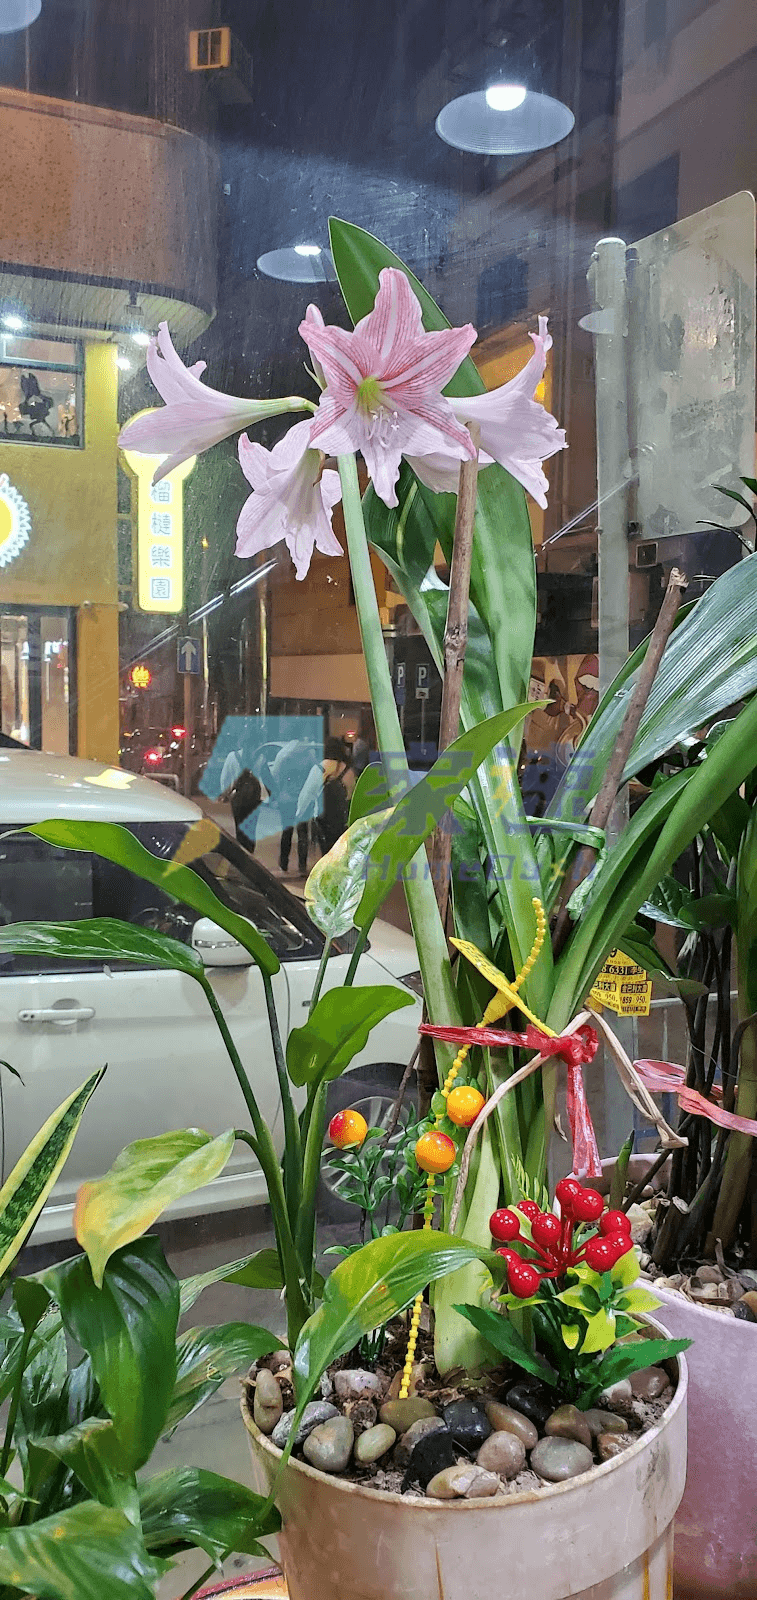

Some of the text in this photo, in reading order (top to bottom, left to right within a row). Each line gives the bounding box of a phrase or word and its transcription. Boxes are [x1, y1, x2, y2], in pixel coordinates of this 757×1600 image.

[397, 666, 404, 685] P
[418, 666, 427, 686] P
[609, 966, 628, 975] 6331
